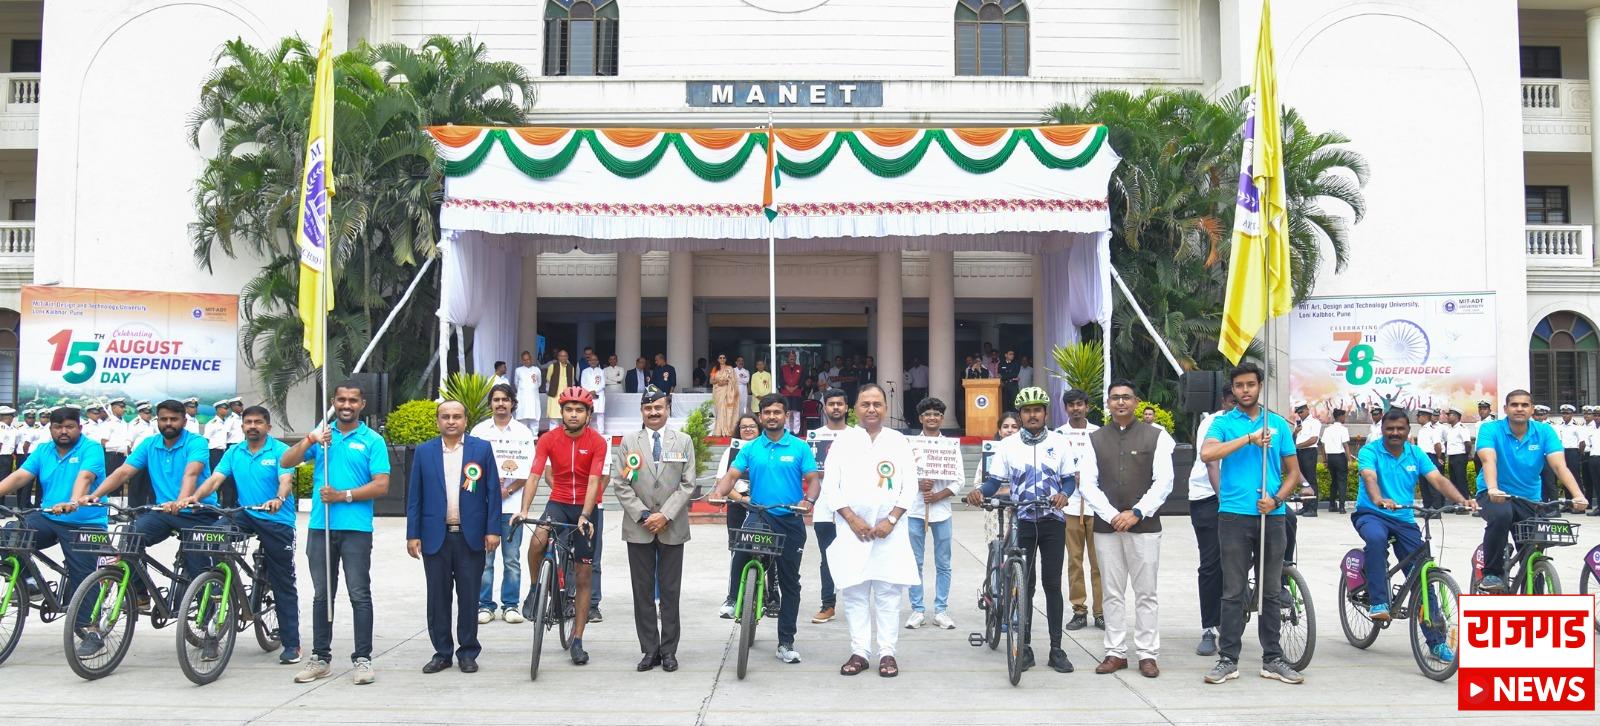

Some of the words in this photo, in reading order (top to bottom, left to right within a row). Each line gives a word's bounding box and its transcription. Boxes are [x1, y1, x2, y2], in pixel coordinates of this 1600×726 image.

[711, 84, 857, 104] MANET
[112, 329, 153, 338] Celebrating
[1364, 335, 1377, 343] TH
[105, 339, 183, 355] AUGUST
[47, 329, 99, 384] 15
[103, 357, 221, 371] INDEPENDENCE
[1374, 366, 1451, 375] INDEPENDENCE
[100, 372, 131, 384] DAY
[1375, 376, 1394, 385] DAY
[1537, 523, 1569, 534] MYBYK
[79, 533, 108, 544] MYBYK
[192, 532, 225, 542] MYBYK
[741, 533, 772, 544] MYBYK
